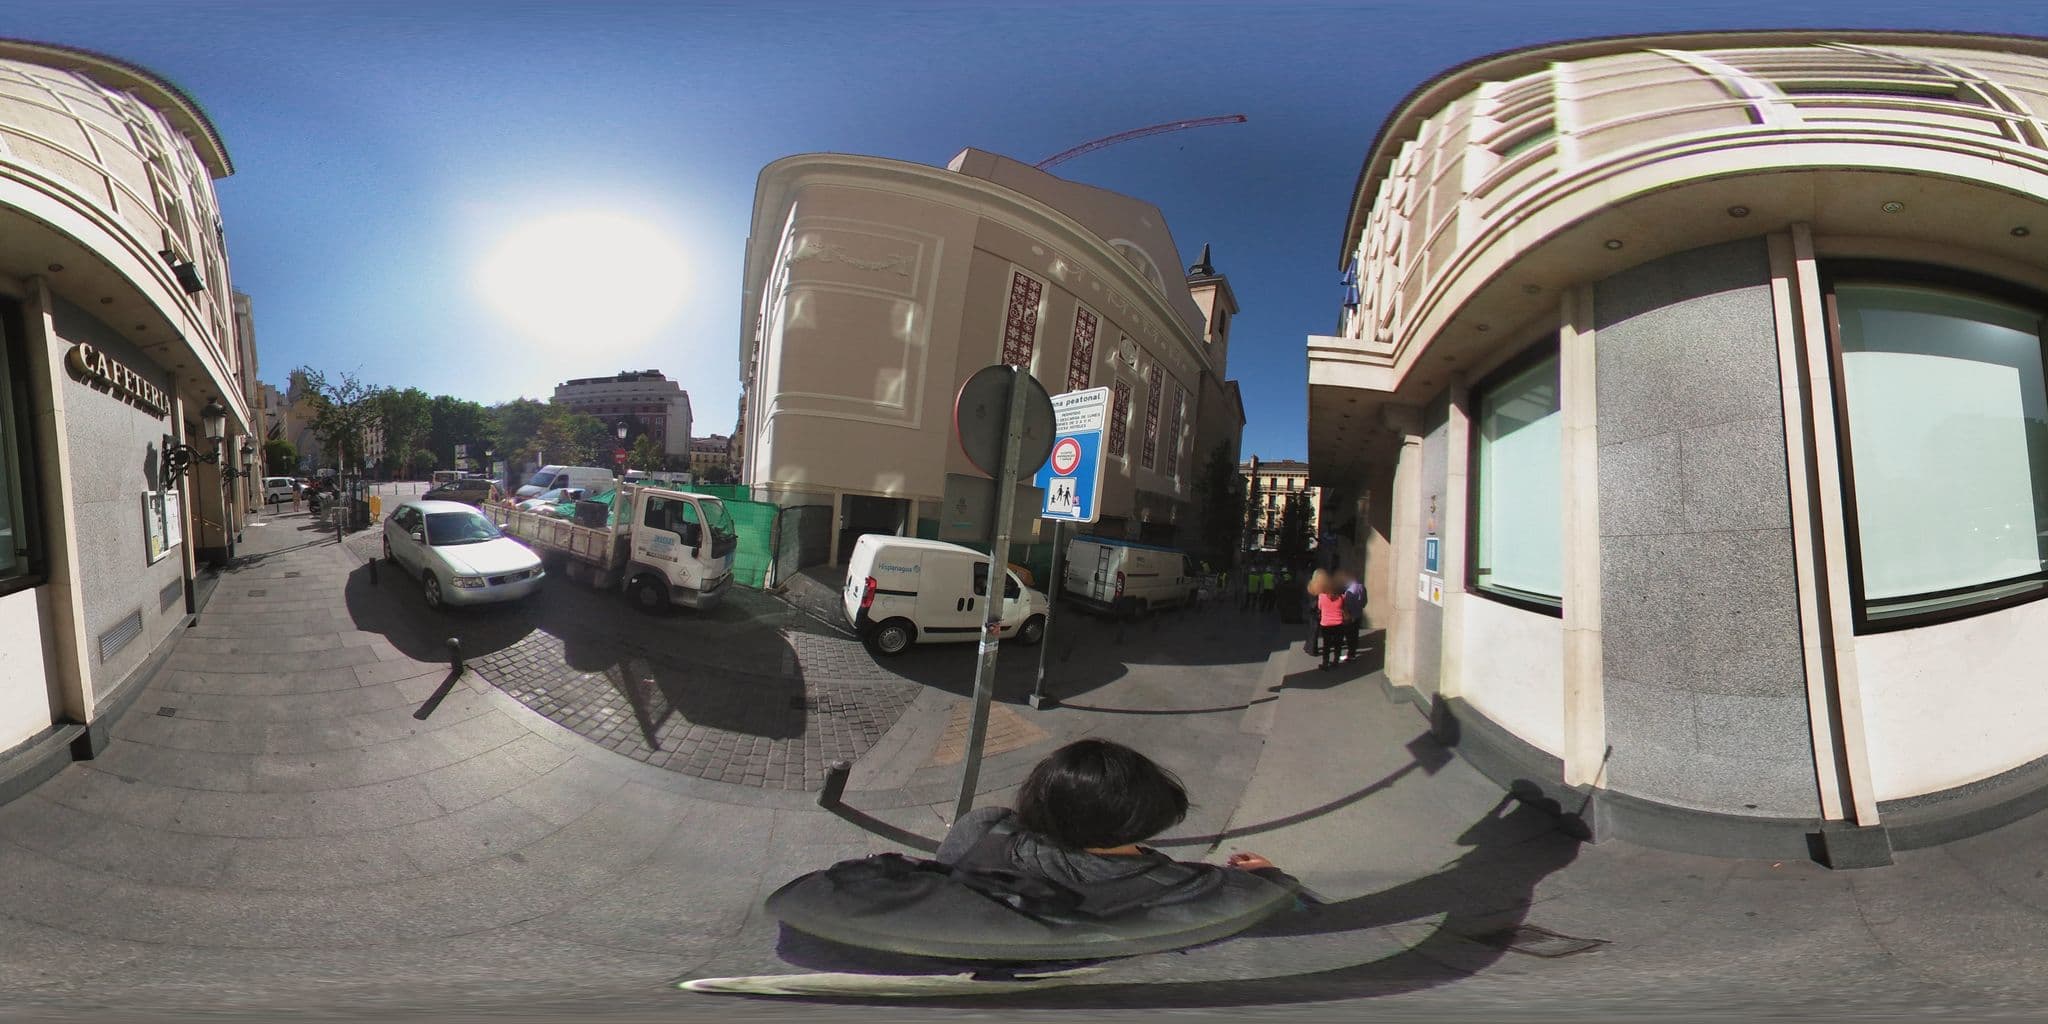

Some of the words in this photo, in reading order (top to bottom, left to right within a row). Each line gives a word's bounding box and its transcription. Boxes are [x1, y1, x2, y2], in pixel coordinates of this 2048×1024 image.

[80, 342, 171, 415] CAFETERIA
[1066, 393, 1100, 406] peatonal
[879, 563, 912, 573] Hispanagua
